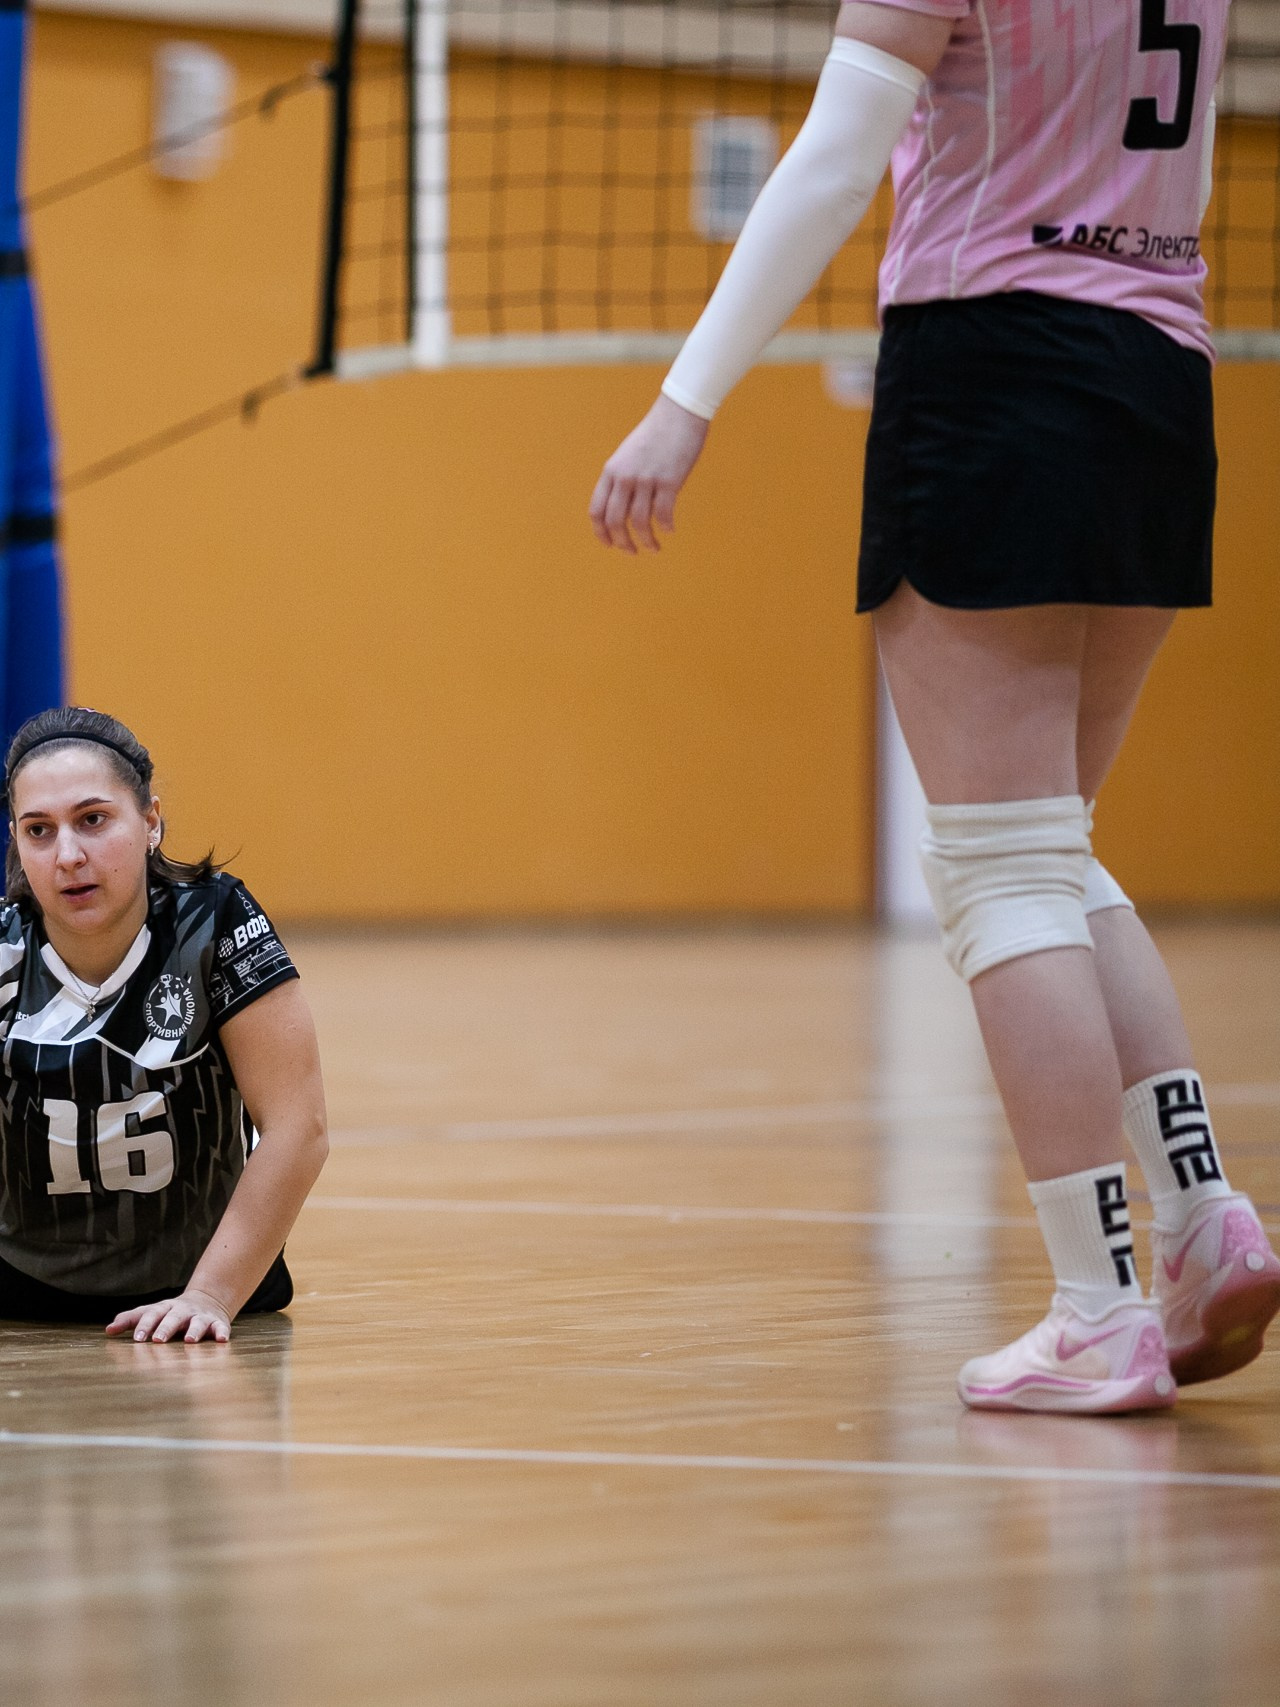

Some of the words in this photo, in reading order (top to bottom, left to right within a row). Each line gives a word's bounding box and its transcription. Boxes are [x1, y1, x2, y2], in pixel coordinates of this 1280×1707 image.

[1122, 0, 1200, 150] 5
[1071, 224, 1128, 254] АБС
[234, 915, 270, 949] ВФВ
[146, 1002, 188, 1038] СПОРТИВНАЯ
[183, 988, 195, 1025] ШКОЛА
[42, 1091, 174, 1195] 16
